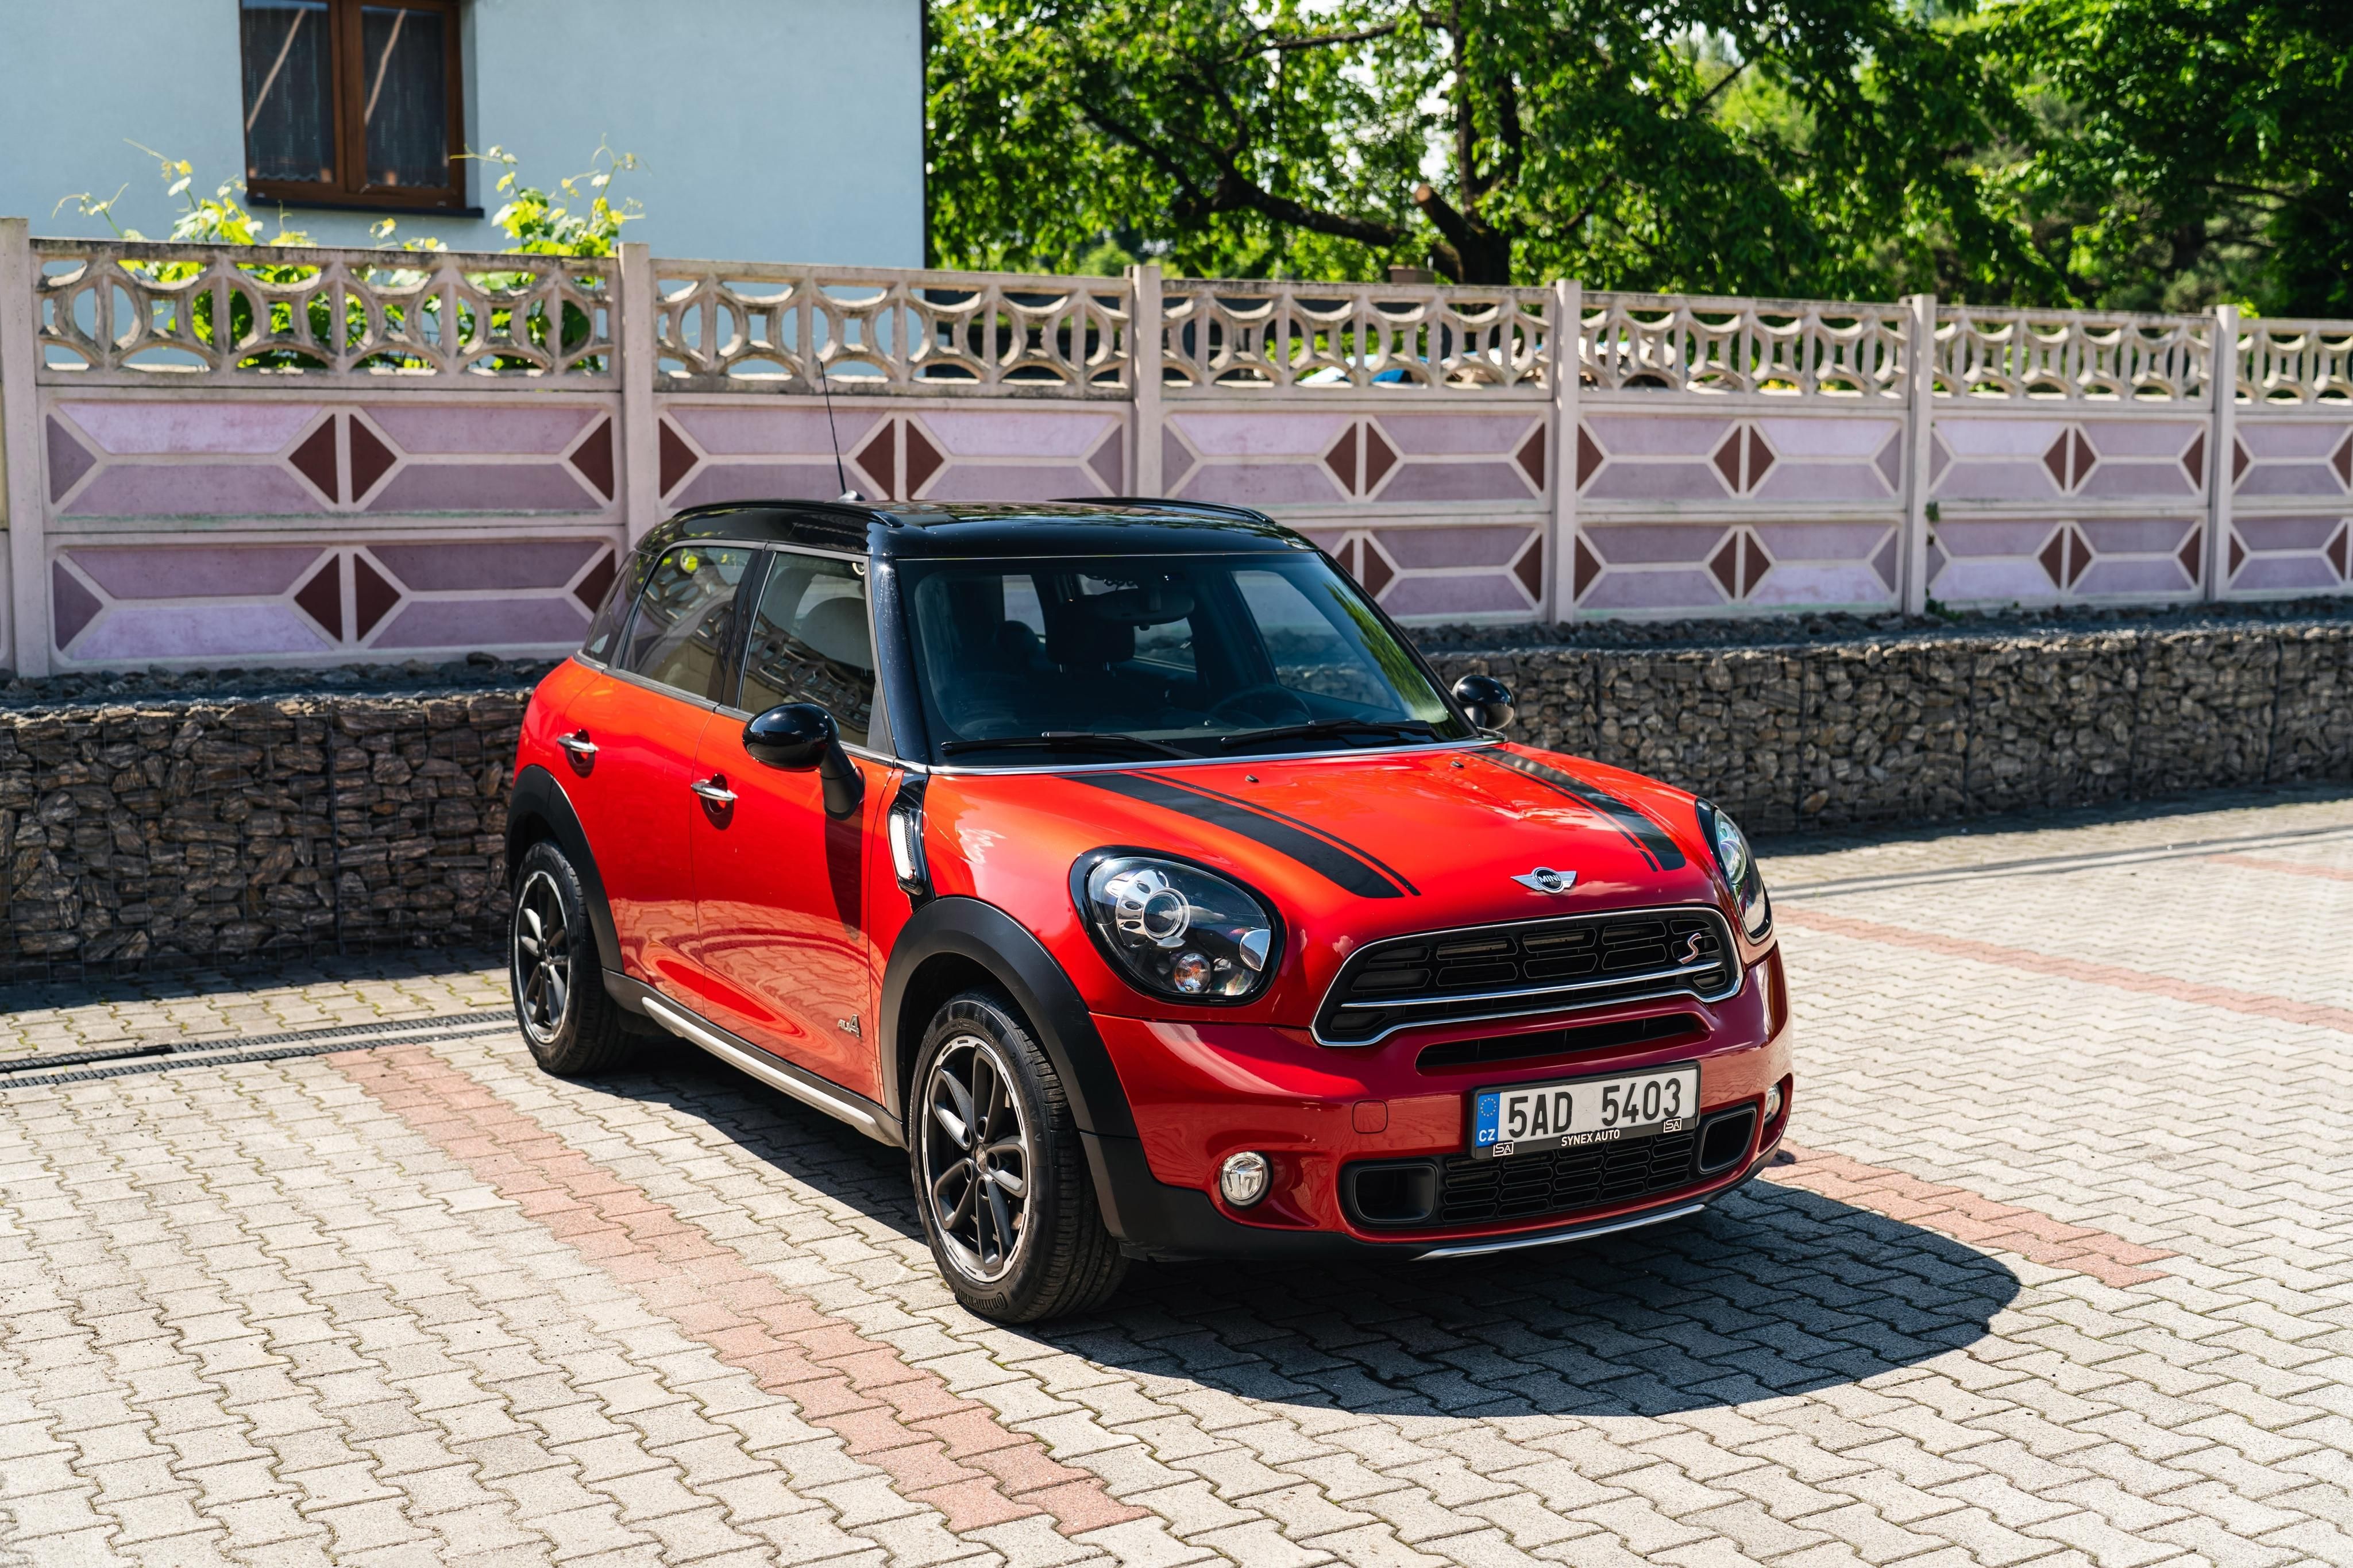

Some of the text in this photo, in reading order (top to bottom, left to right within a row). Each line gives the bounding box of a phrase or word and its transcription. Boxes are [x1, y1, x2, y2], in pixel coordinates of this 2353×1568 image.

[1538, 875, 1561, 883] MINI
[1677, 933, 1702, 964] S
[1508, 1077, 1681, 1138] 5AD 5403
[1478, 1129, 1496, 1142] CZ
[1561, 1129, 1620, 1147] SYNEX AUTO
